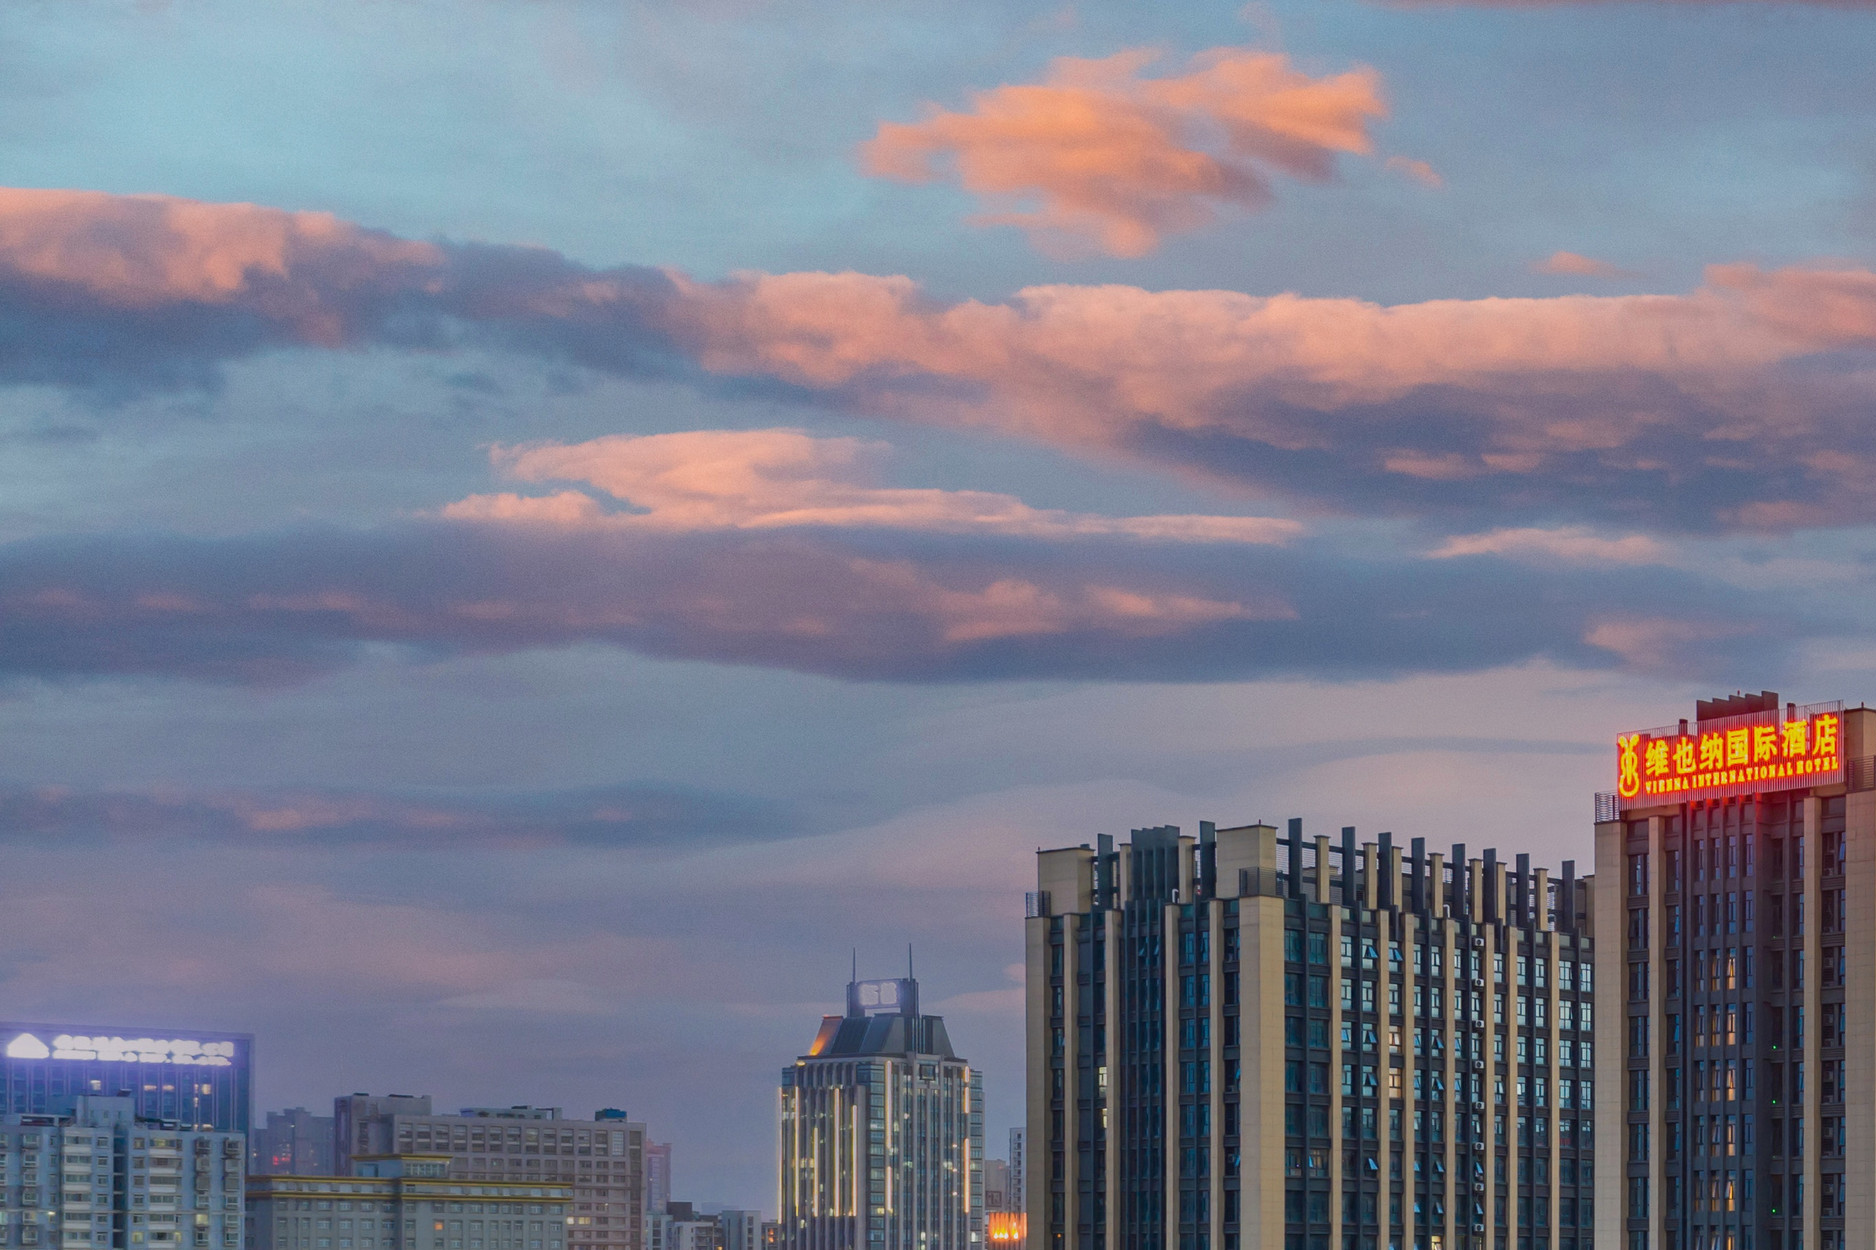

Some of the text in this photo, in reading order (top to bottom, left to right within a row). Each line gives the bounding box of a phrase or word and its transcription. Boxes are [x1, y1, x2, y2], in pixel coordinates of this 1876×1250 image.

[1645, 714, 1839, 776] 维也纳国际酒店
[1645, 756, 1839, 795] VIENNA INTERNATIONAL HOTEL
